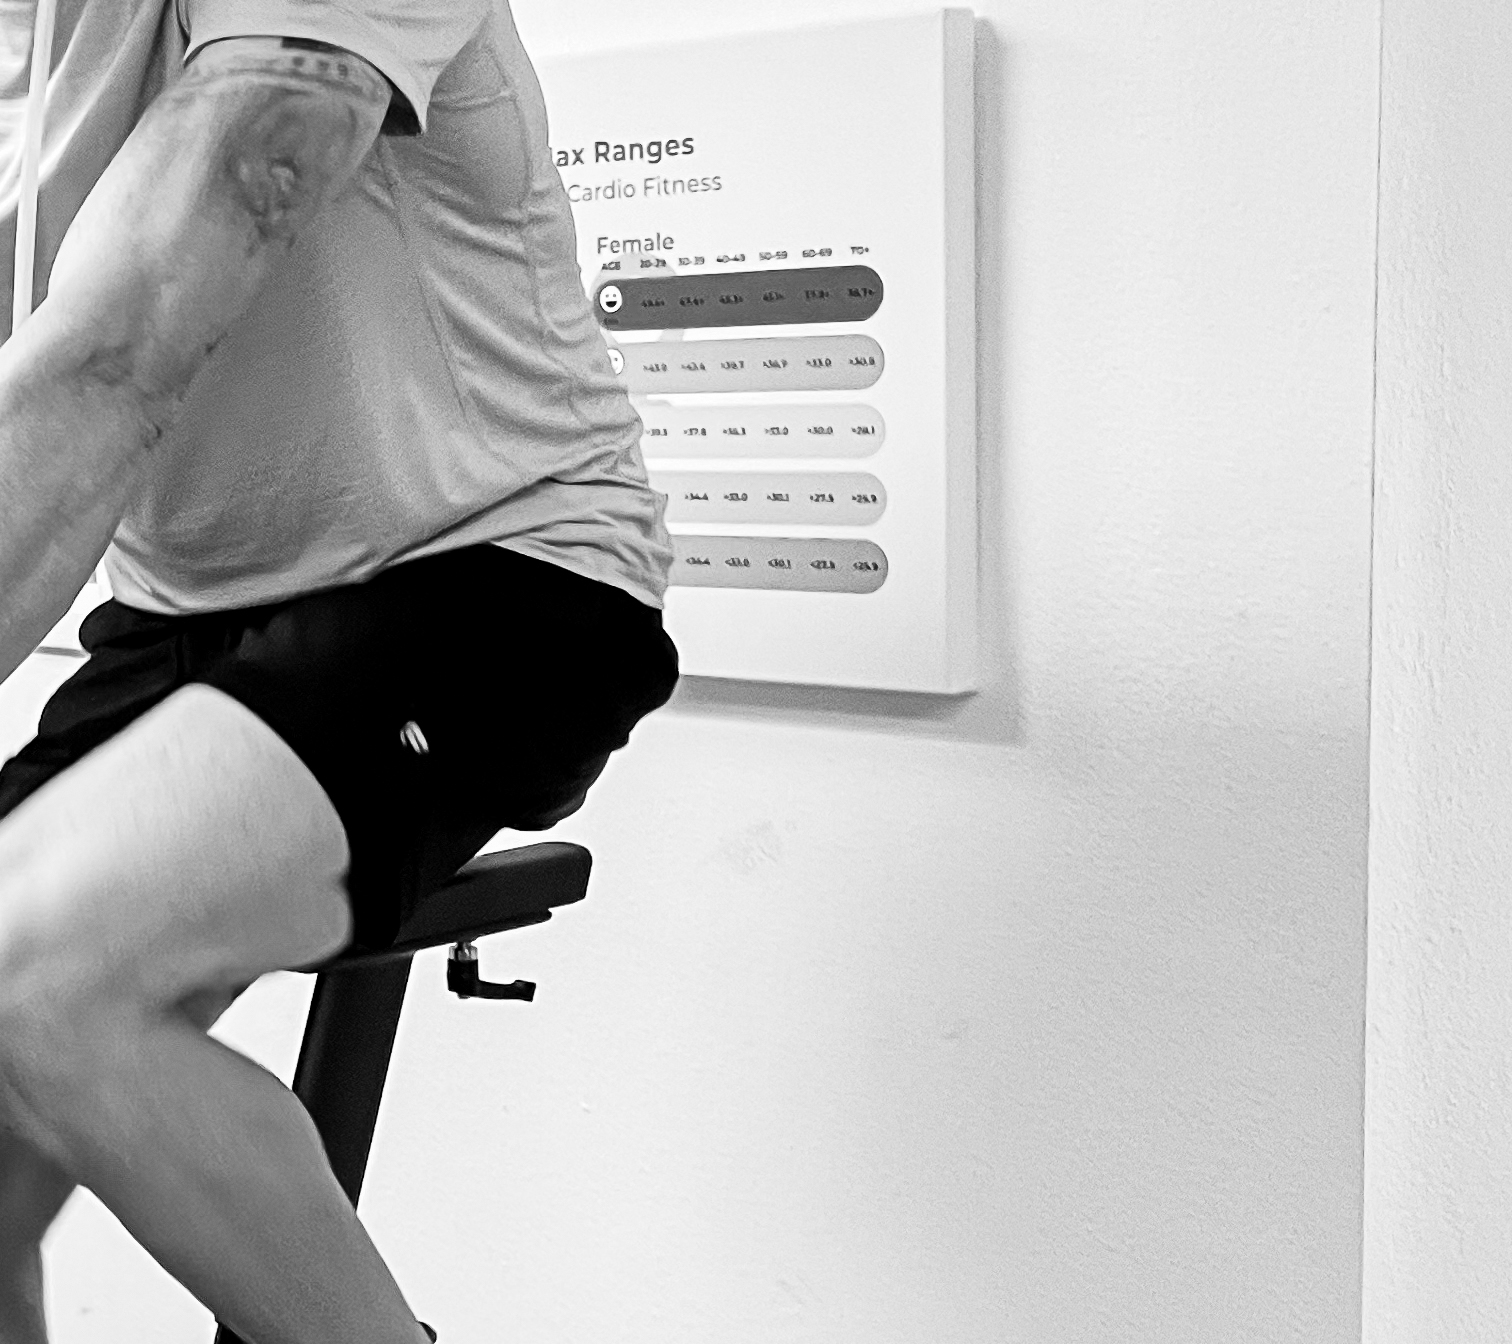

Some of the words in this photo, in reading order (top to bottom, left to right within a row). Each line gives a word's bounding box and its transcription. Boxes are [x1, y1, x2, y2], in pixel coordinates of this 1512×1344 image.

[557, 146, 585, 167] ax
[594, 137, 695, 164] Ranges
[568, 178, 636, 203] Cardio
[644, 174, 722, 197] Fitness
[597, 233, 674, 254] Female
